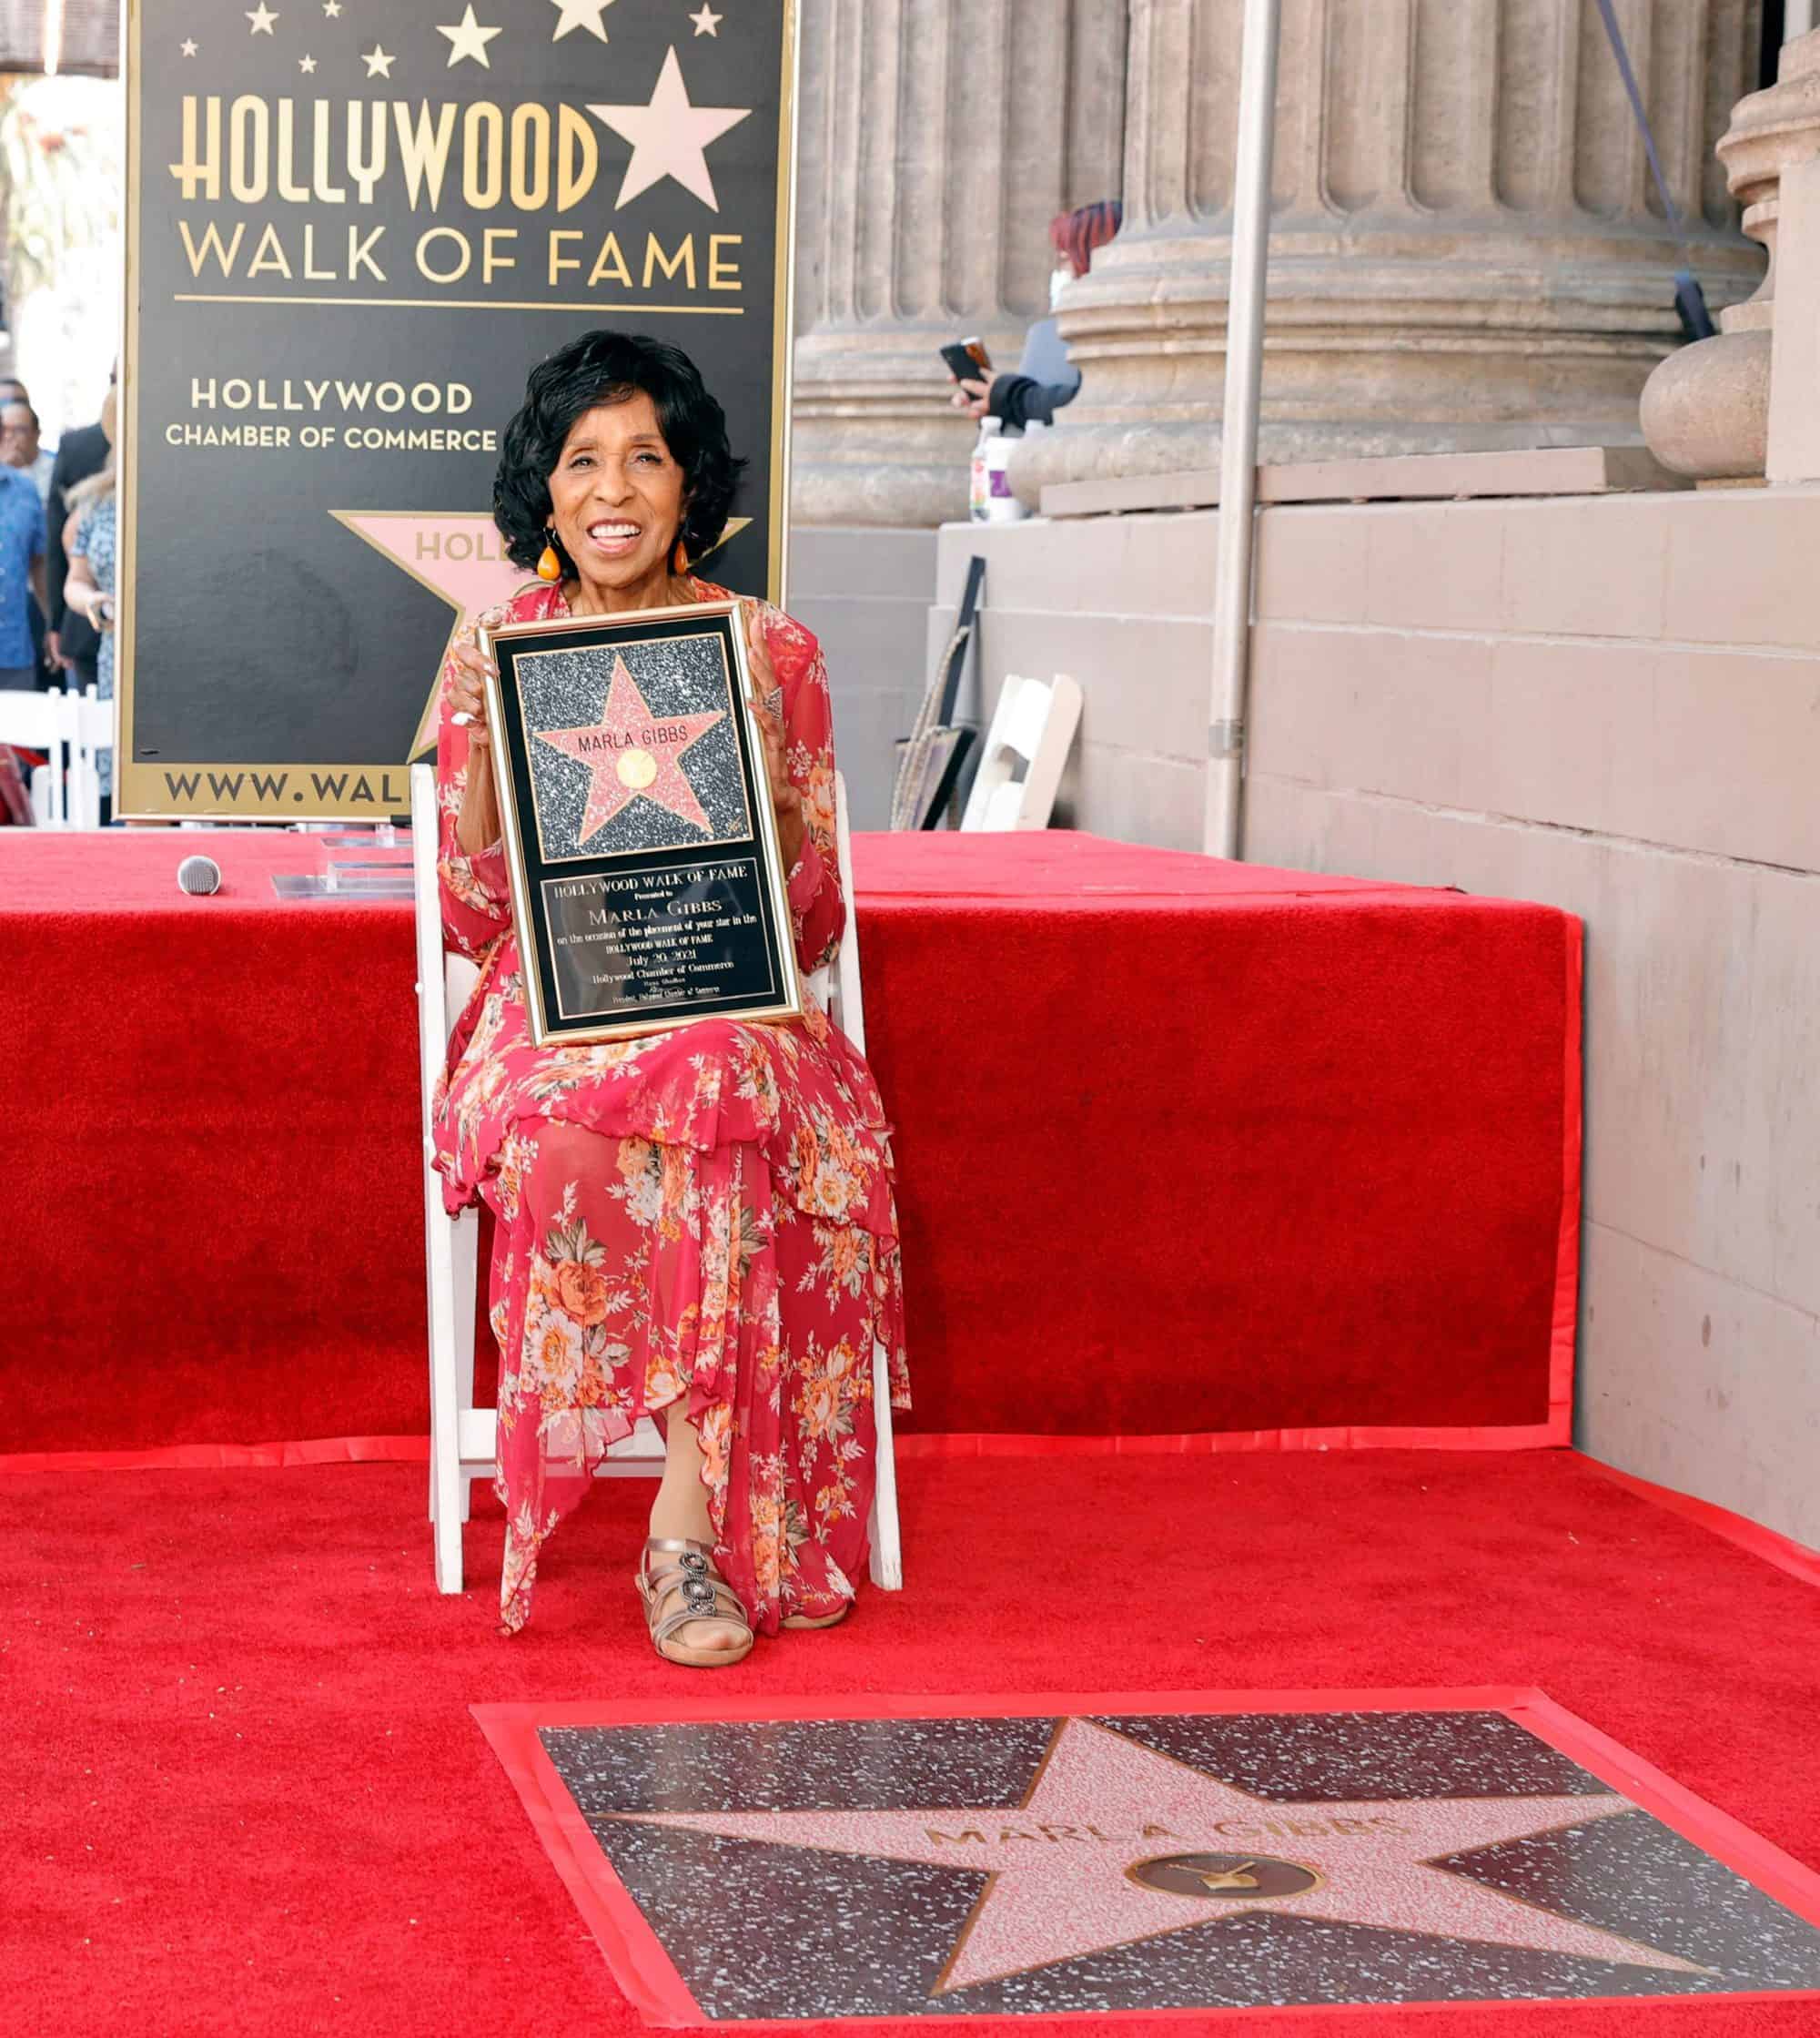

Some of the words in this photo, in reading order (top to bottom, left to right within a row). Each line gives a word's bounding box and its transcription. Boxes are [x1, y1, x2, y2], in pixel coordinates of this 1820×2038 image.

[168, 94, 599, 213] HOLLYWOOD
[178, 221, 387, 281] WALK
[415, 226, 518, 283] OF
[548, 229, 743, 290] FAME
[190, 378, 473, 414] HOLLYWOOD
[165, 424, 291, 448] CHAMBER
[298, 427, 336, 448] OF
[343, 428, 498, 452] COMMERCE
[578, 731, 634, 752] MARLA
[641, 725, 688, 745] GIBBS
[164, 772, 412, 803] WWW.WAL
[554, 878, 638, 898] HOLLYWOOD
[642, 873, 684, 888] WALK
[687, 870, 704, 883] OF
[708, 866, 748, 881] FAME
[628, 926, 642, 938] the
[743, 913, 757, 924] the
[605, 941, 654, 954] HOLLYWOOD
[654, 938, 678, 948] WALK
[692, 933, 714, 945] FAME
[627, 954, 649, 967] July
[672, 948, 697, 961] 2021
[592, 970, 634, 984] Hollywood
[925, 1825, 1185, 1846] MARLA
[1213, 1819, 1412, 1837] GIBBS
